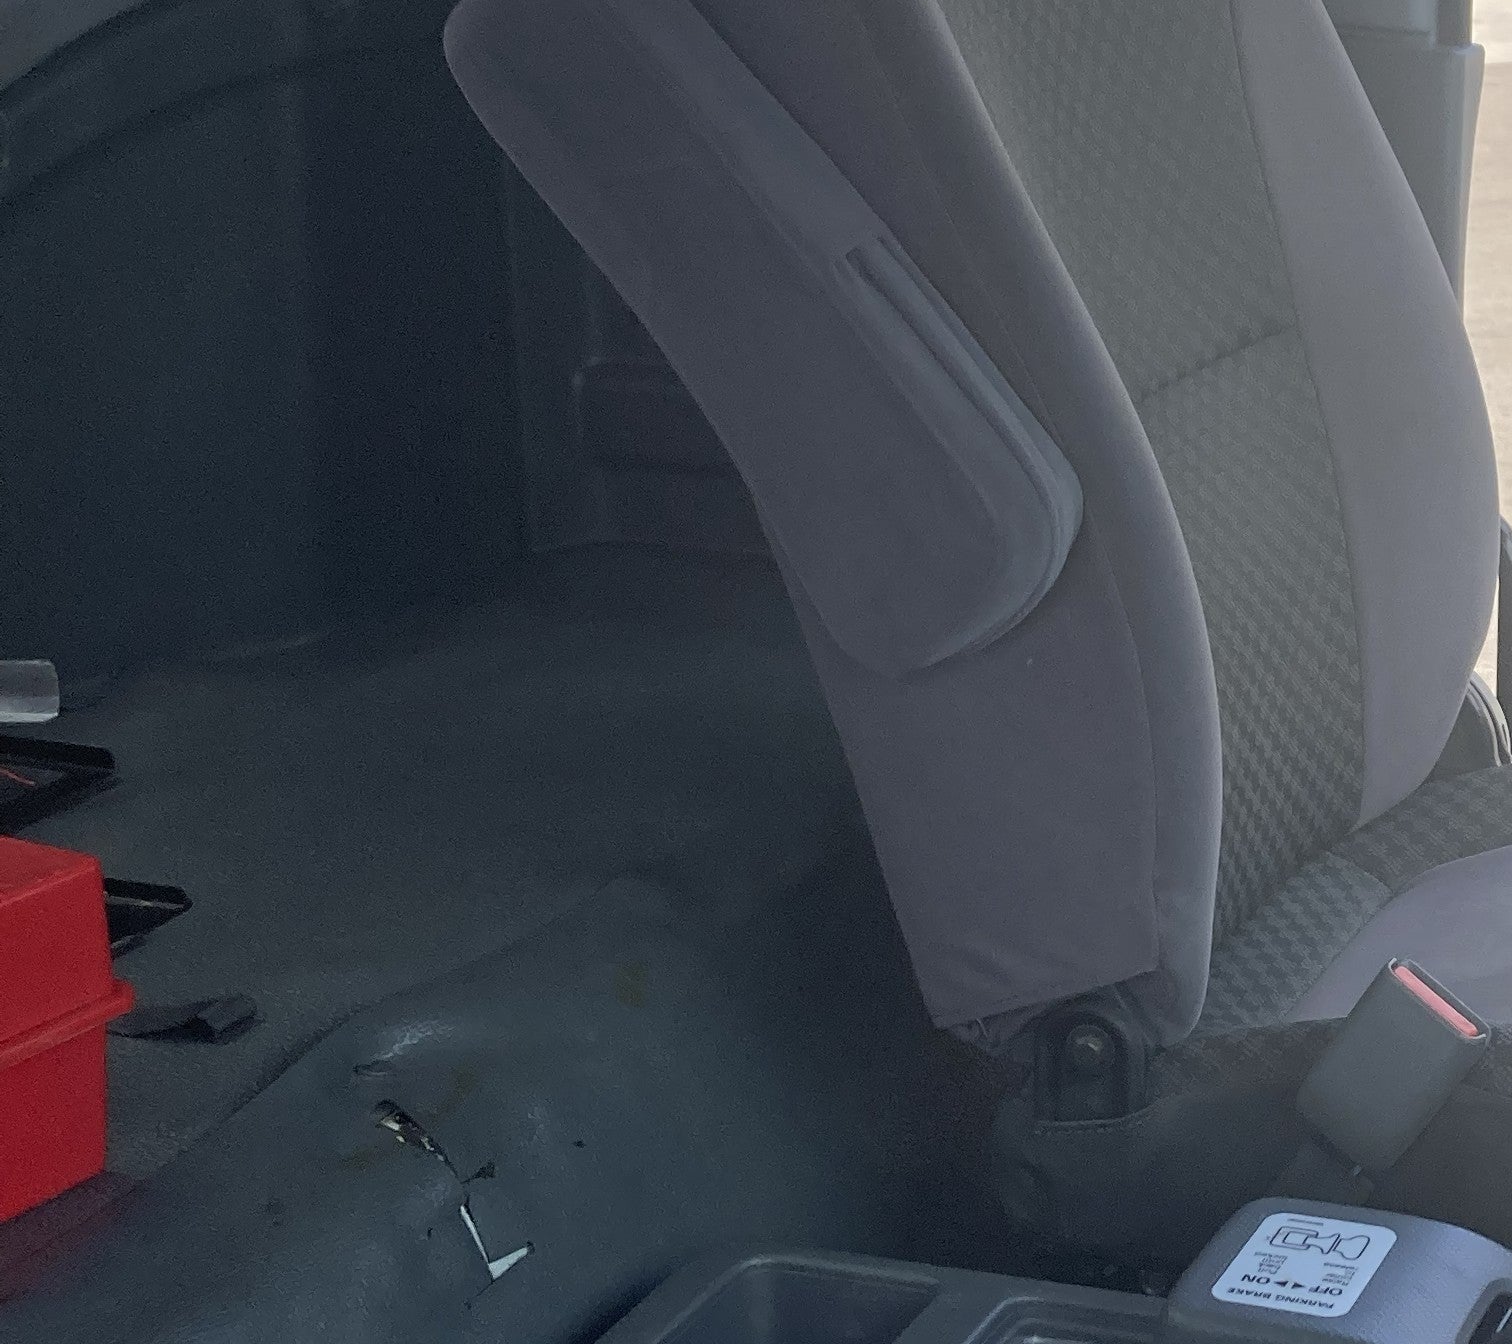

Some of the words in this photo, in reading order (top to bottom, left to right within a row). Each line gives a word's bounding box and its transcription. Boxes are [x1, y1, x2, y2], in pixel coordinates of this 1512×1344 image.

[1240, 1274, 1271, 1284] ON
[1228, 1287, 1271, 1300] BRAKE
[1308, 1285, 1343, 1296] OFF
[1275, 1293, 1335, 1309] PARKING
